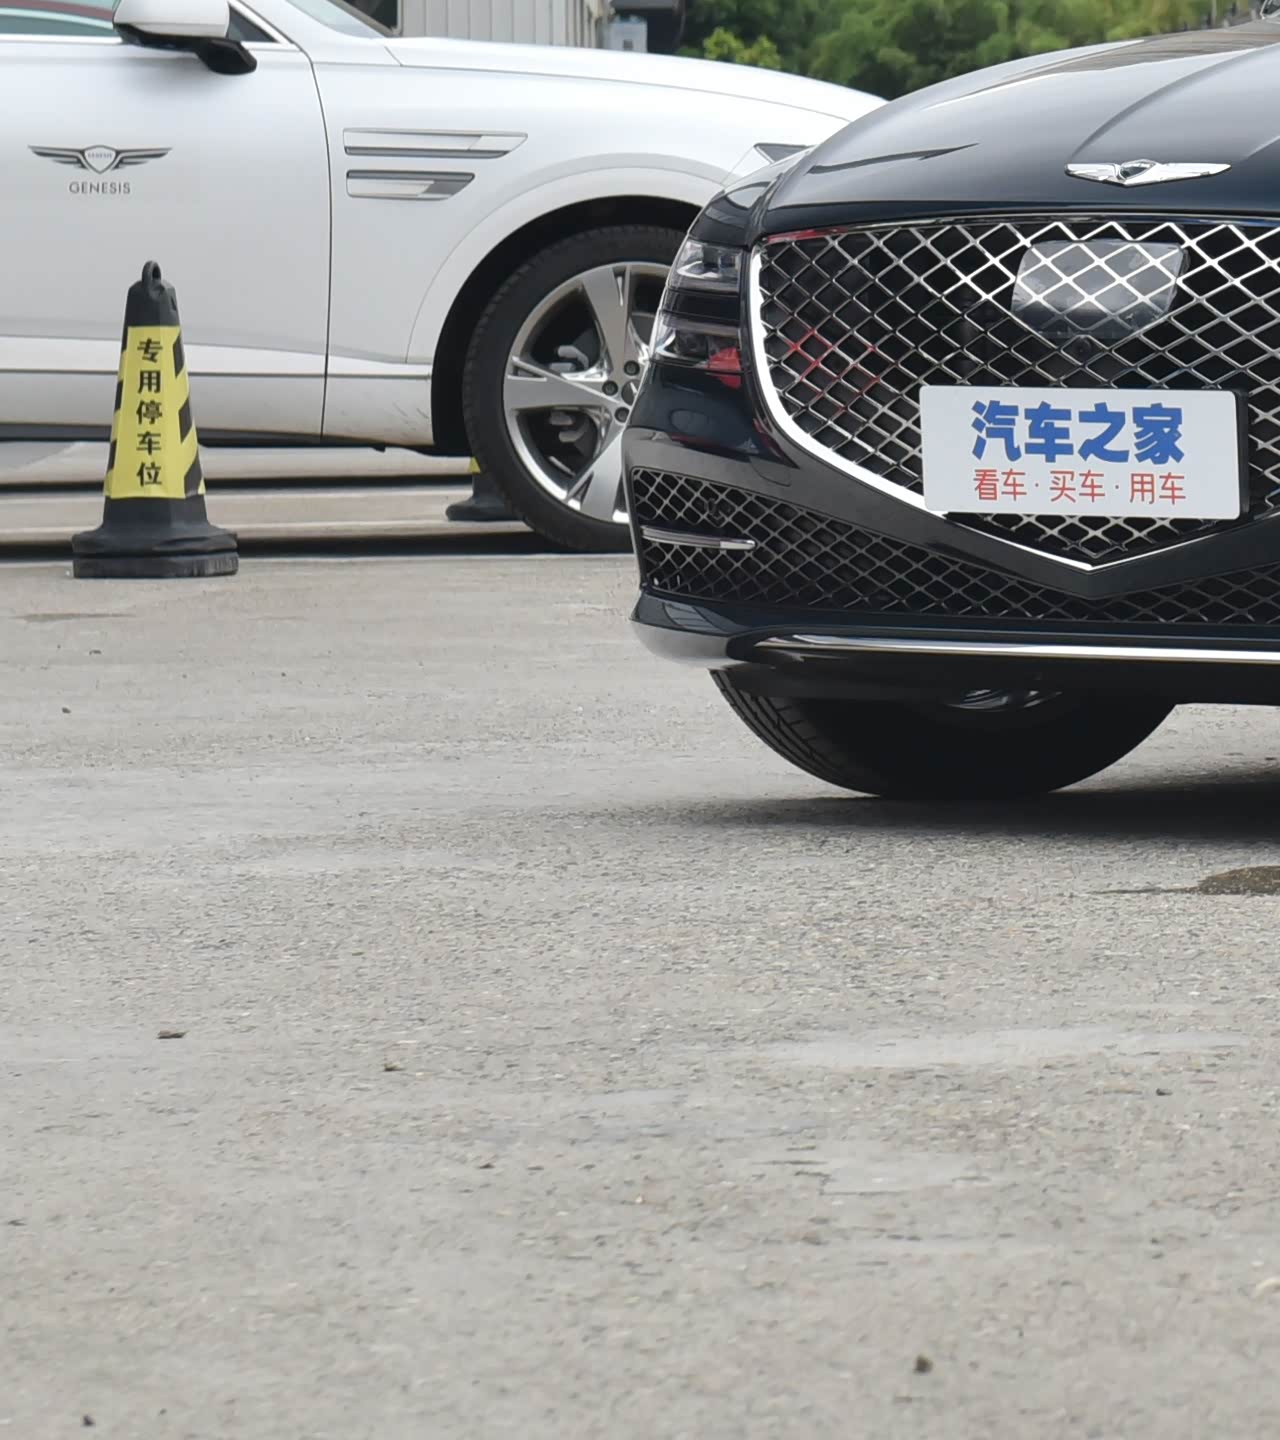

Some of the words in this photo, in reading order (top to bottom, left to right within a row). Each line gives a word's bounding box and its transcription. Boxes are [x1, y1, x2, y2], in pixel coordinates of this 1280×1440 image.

[68, 181, 131, 194] GENESIS
[136, 338, 163, 487] 专用停车位
[971, 399, 1185, 465] 汽车之家
